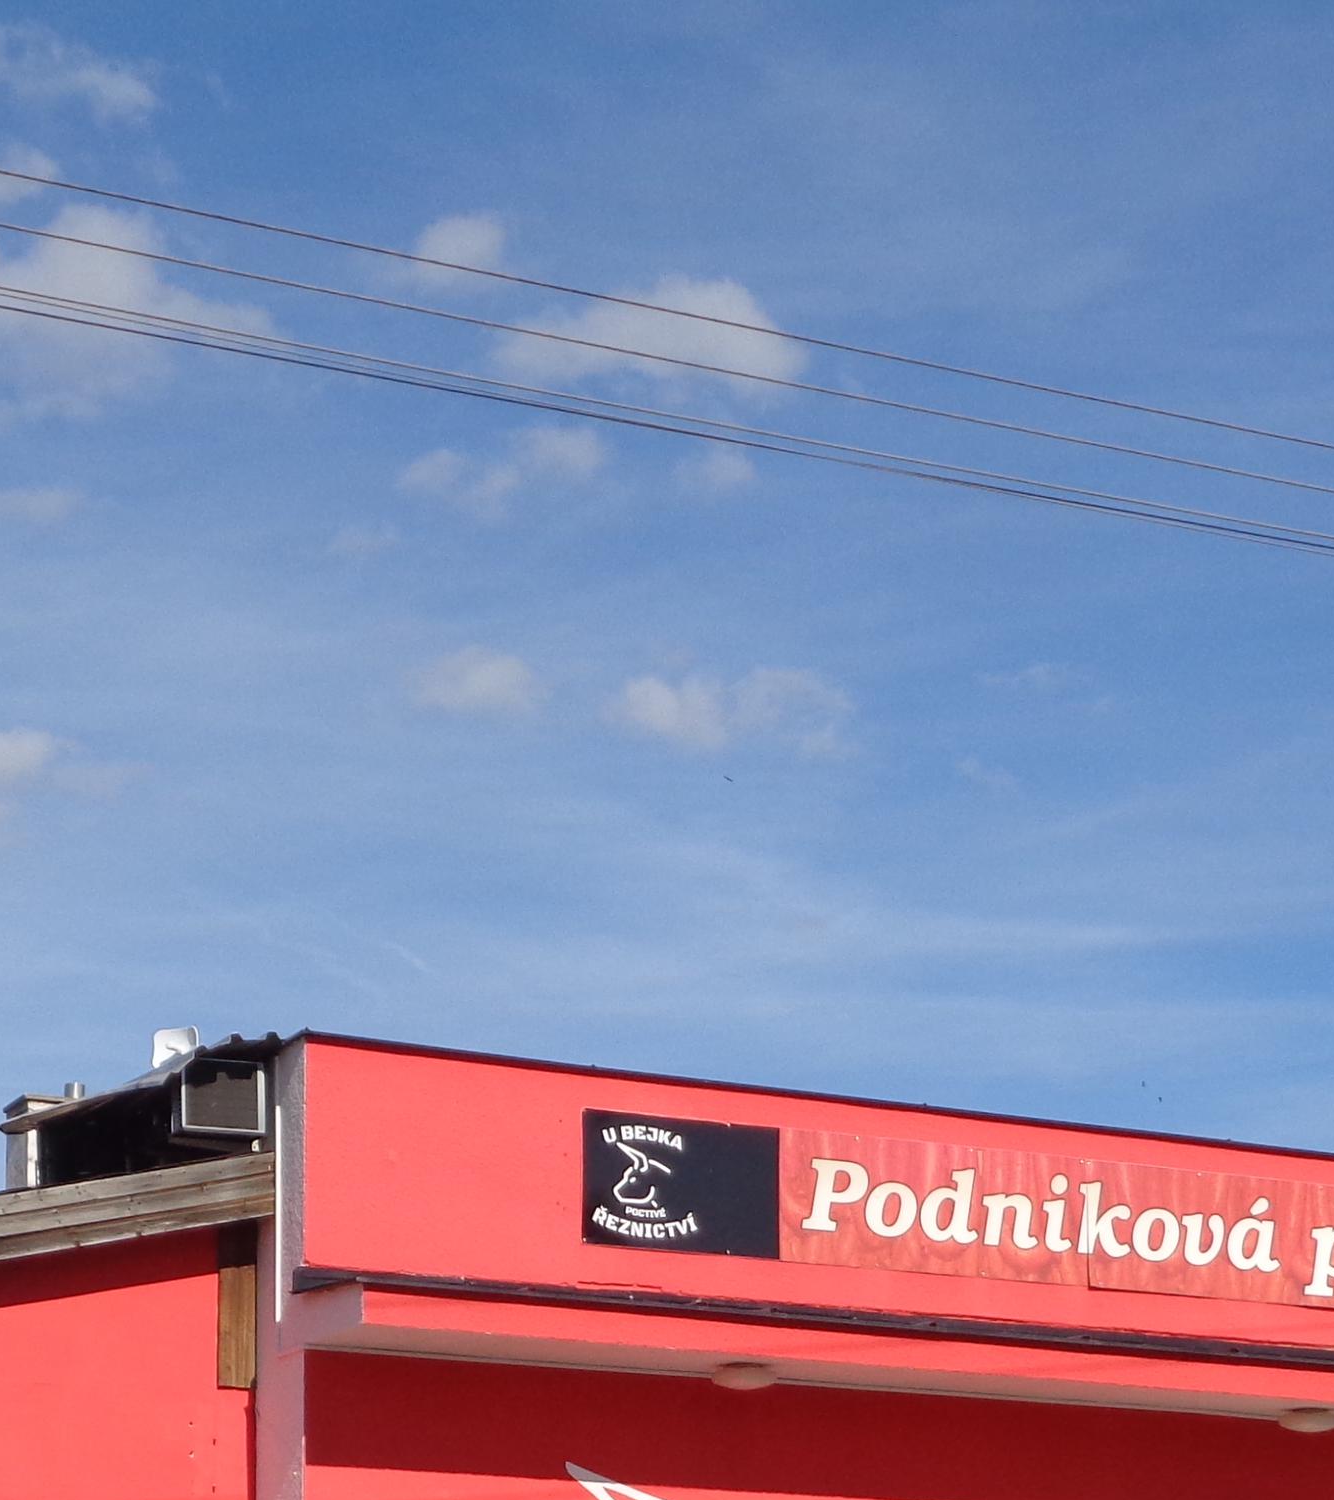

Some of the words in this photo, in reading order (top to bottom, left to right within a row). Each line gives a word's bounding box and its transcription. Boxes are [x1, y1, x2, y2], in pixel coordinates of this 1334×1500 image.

[602, 1127, 617, 1143] U
[620, 1125, 683, 1151] BEJKA
[592, 1205, 698, 1239] ŘEZNICTVÍ
[801, 1157, 1281, 1273] Podniková
